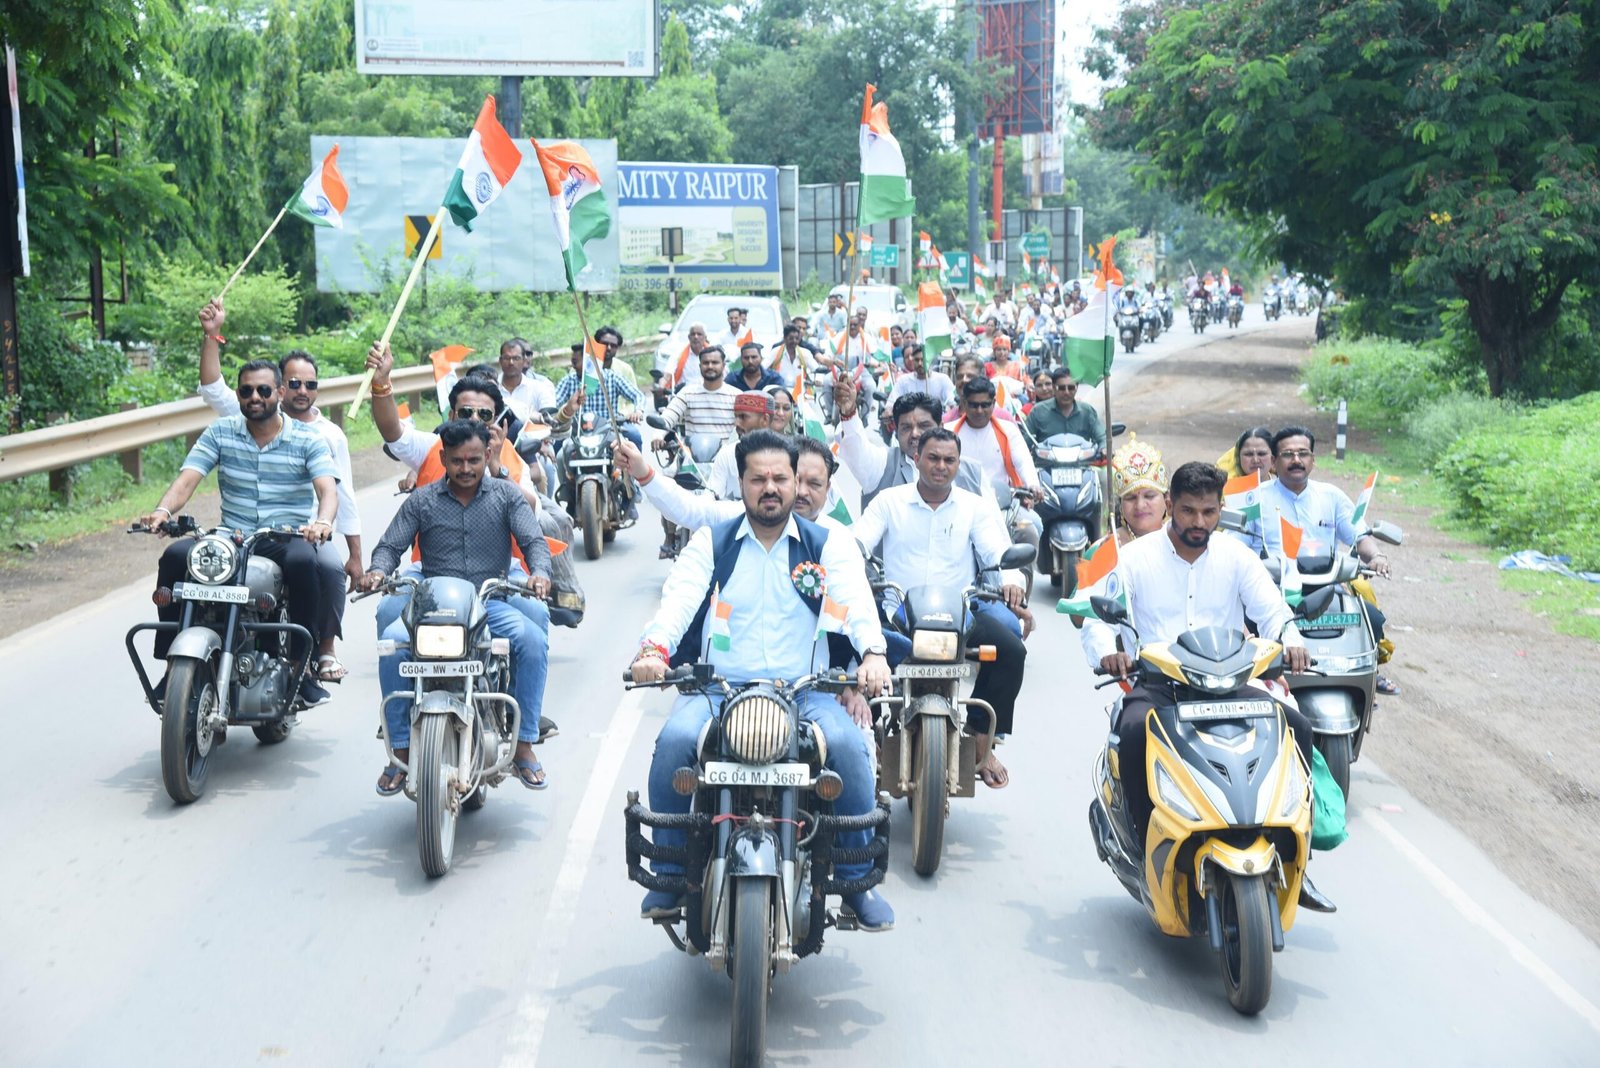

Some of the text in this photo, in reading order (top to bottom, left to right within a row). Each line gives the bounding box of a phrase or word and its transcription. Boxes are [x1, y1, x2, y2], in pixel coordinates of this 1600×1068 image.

[618, 169, 768, 200] MITY RAIPUR
[183, 589, 196, 597] CG
[225, 593, 248, 601] 8580
[433, 665, 446, 674] MW
[709, 771, 804, 785] CG 04 MJ 3687
